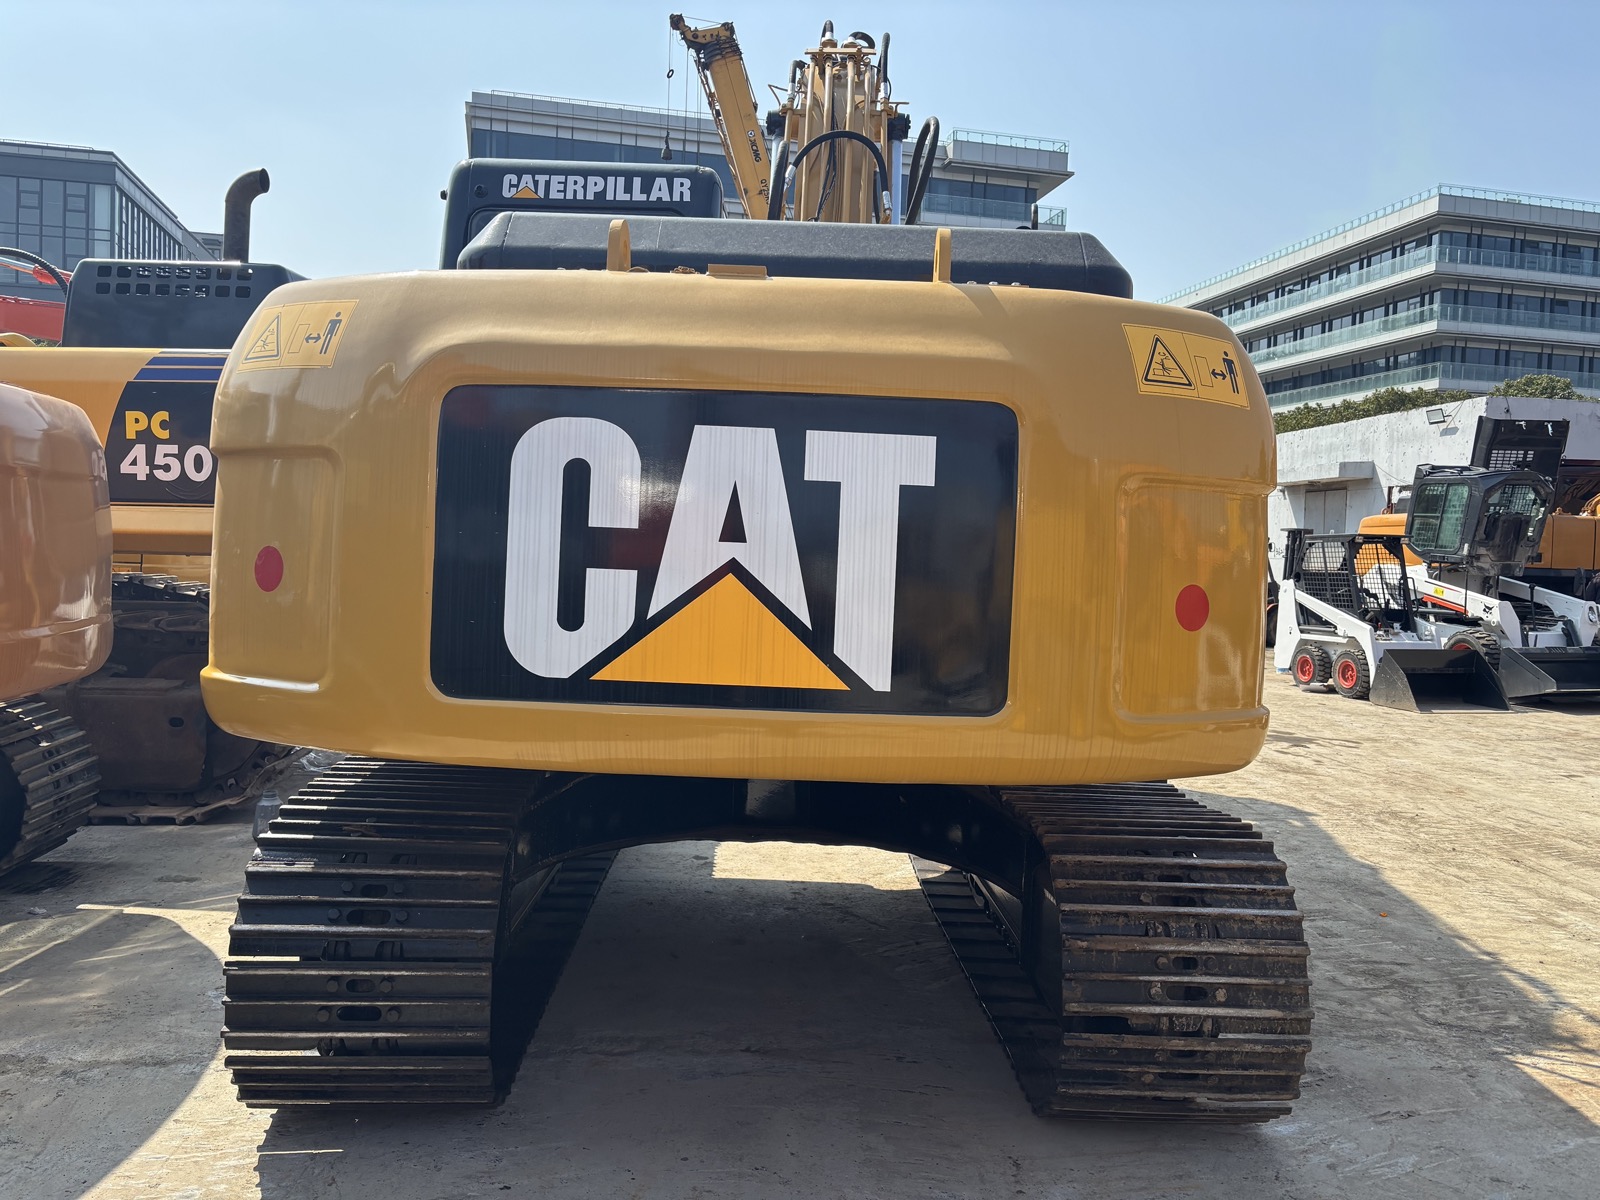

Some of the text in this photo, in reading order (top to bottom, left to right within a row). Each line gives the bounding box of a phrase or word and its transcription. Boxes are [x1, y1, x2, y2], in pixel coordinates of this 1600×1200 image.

[749, 139, 762, 163] XCMG
[502, 174, 691, 202] CATERPILLAR
[125, 410, 170, 440] PC
[120, 444, 213, 482] 450
[503, 416, 937, 692] CAT
